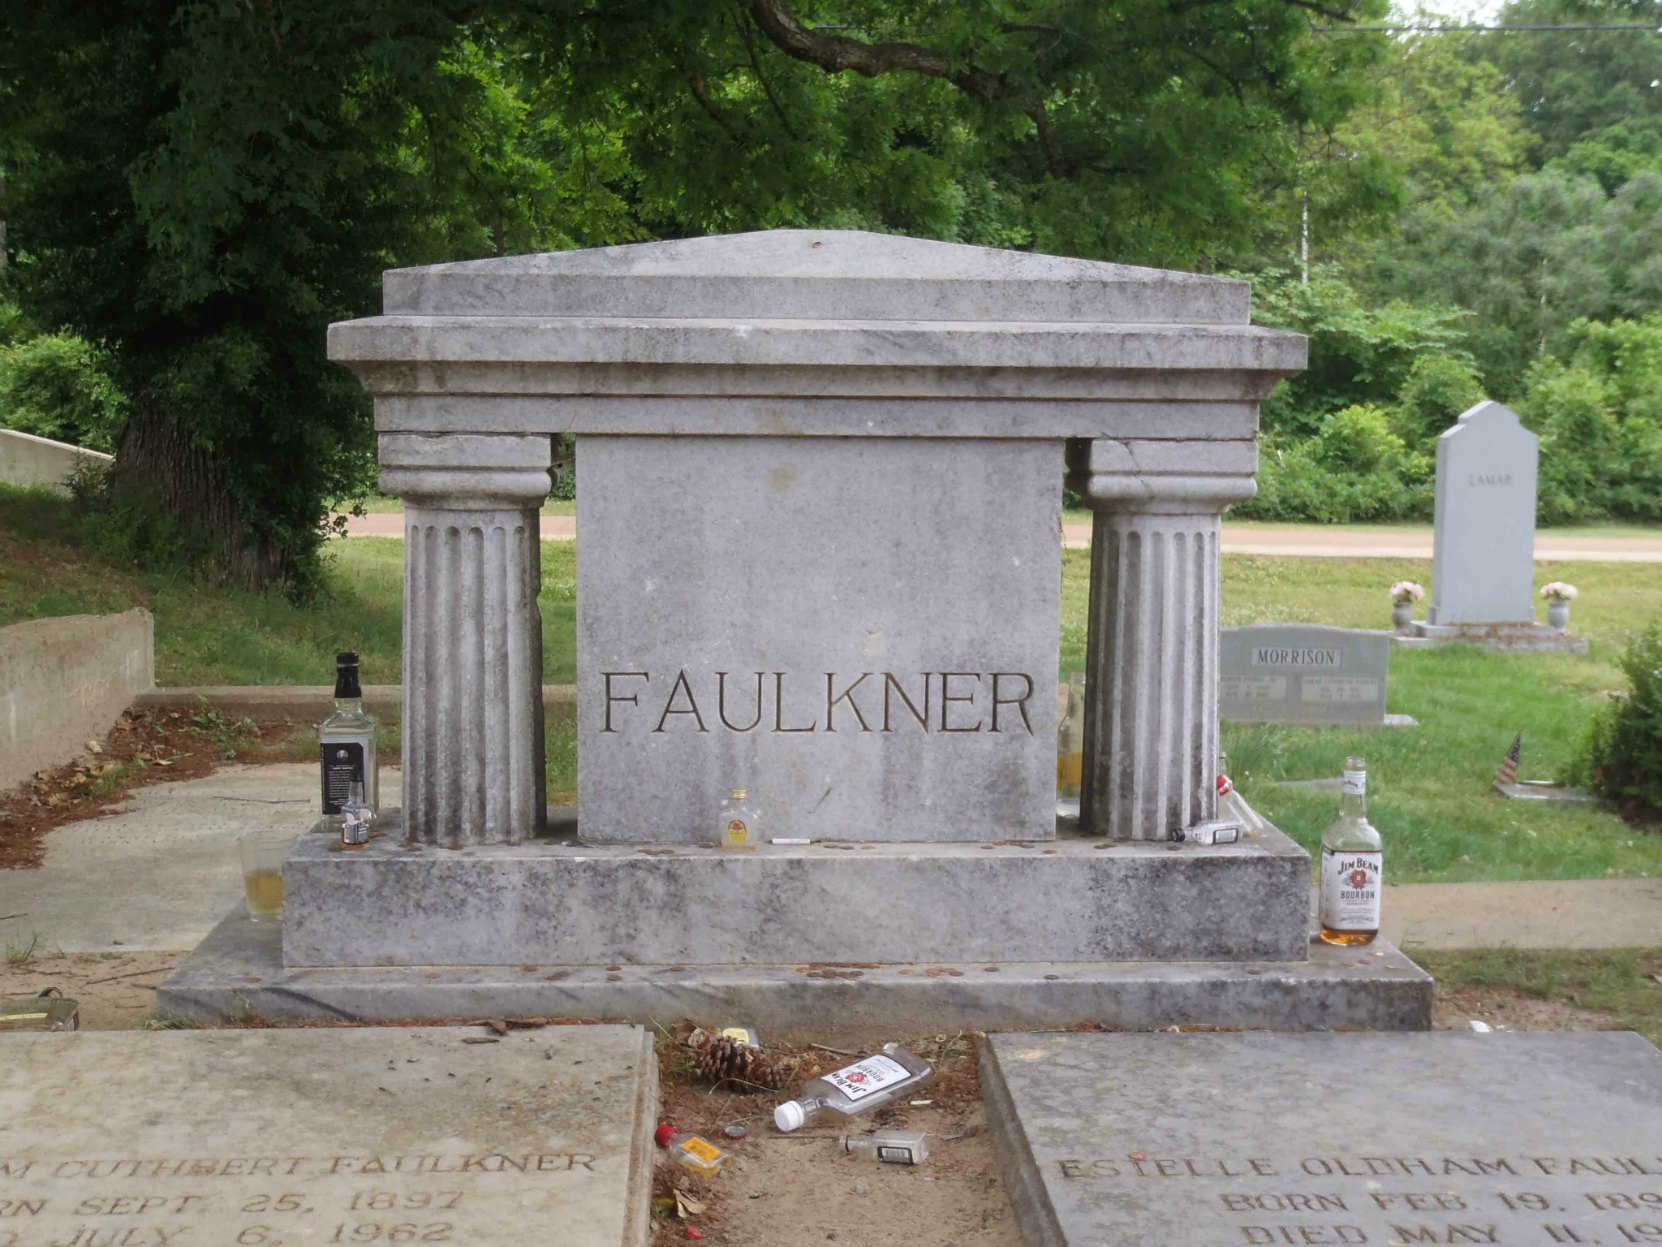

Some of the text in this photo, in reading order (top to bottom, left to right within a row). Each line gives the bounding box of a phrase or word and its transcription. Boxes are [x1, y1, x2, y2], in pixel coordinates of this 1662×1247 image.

[1468, 473, 1512, 488] LAMAR
[1257, 649, 1335, 666] MORRISON
[600, 670, 1035, 736] FAULKNER
[1340, 890, 1375, 899] BOURBON
[53, 1156, 312, 1179] CUTHBERT
[320, 1153, 596, 1175] FAULKNER
[1056, 1156, 1662, 1178] ESTELLE OLDHAM FAUL
[345, 1191, 464, 1210] 1897
[1219, 1192, 1350, 1211] BORN
[53, 1223, 192, 1247] JULY
[328, 1221, 454, 1243] 1962
[1240, 1224, 1368, 1245] DIED
[1391, 1223, 1499, 1244] MAY
